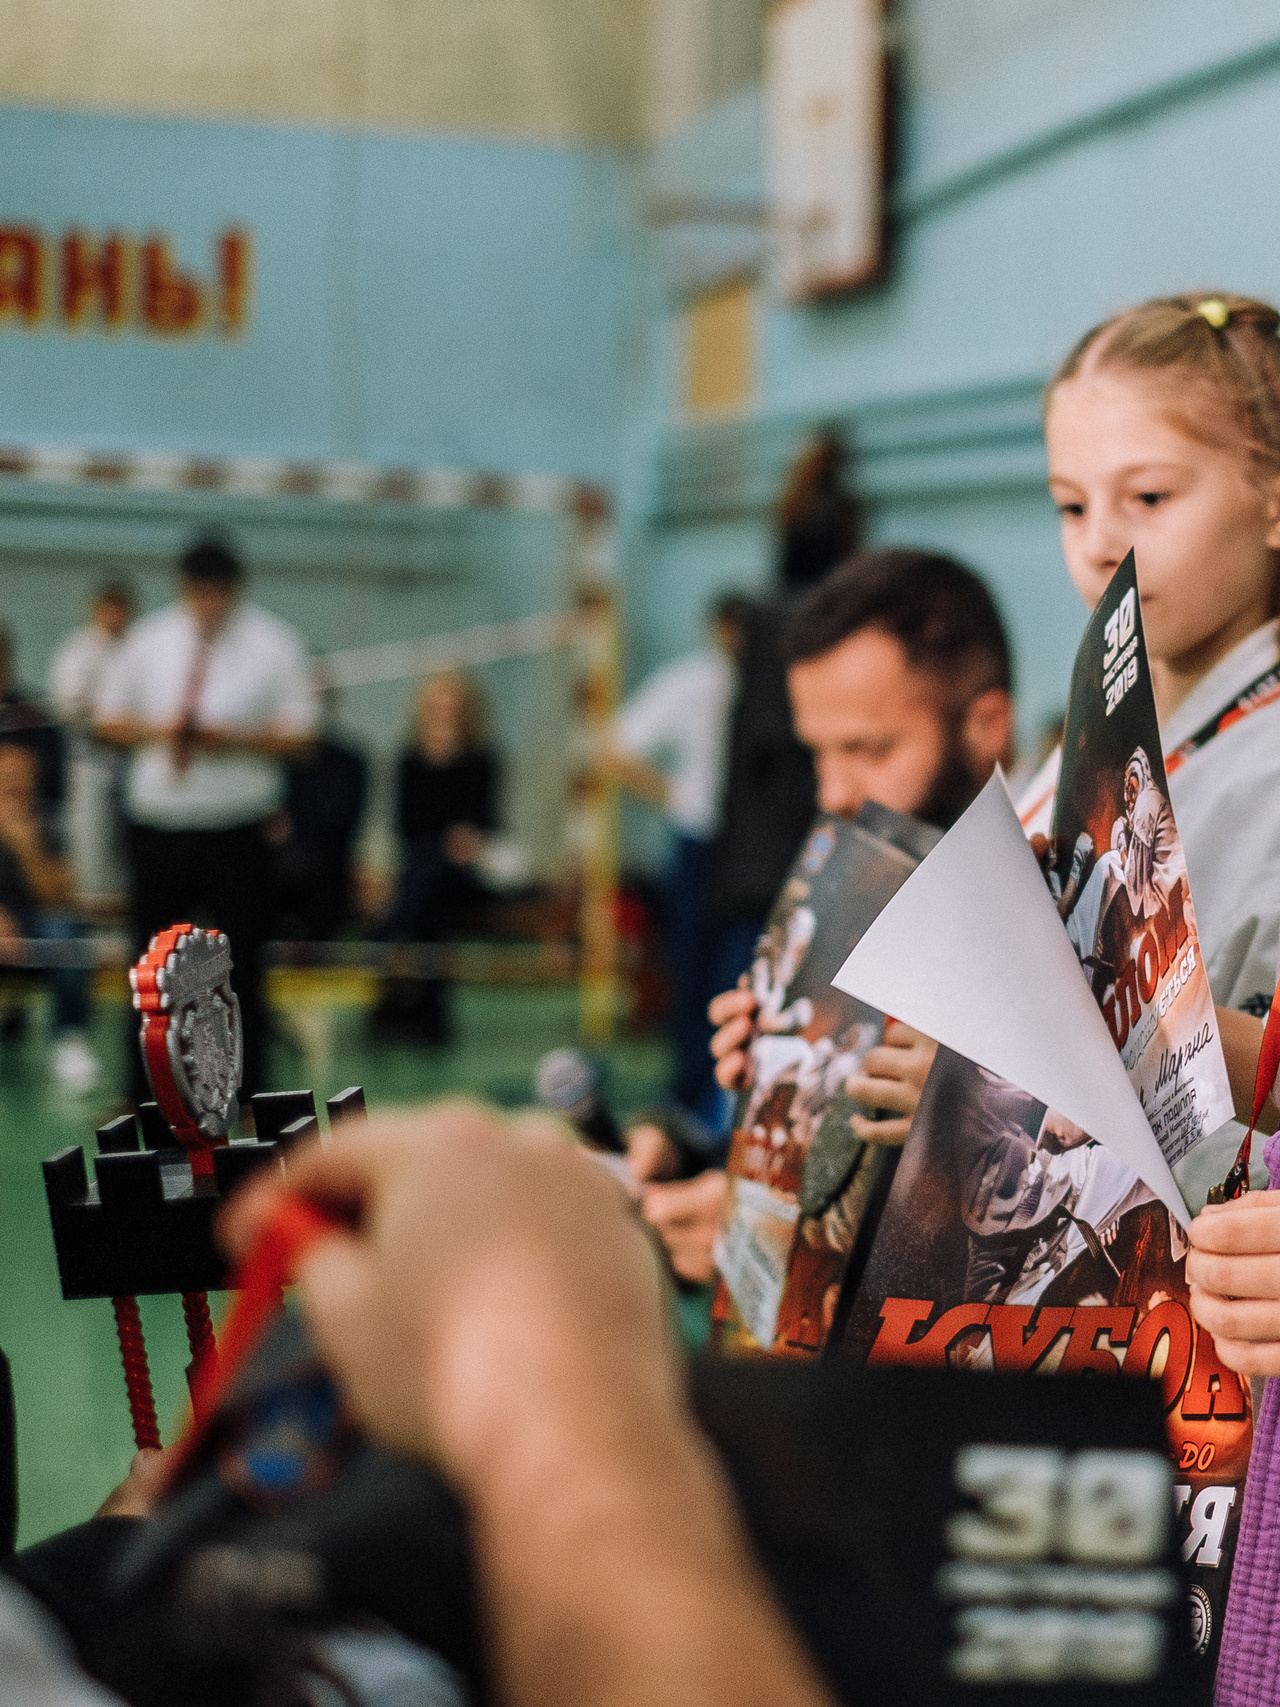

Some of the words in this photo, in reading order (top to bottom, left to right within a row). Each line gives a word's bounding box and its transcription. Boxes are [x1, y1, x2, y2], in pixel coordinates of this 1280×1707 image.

[1103, 587, 1136, 670] 30
[1105, 656, 1138, 716] 2019
[1163, 1088, 1197, 1126] ПОДІЛЛЯ
[1179, 1441, 1216, 1471] DO
